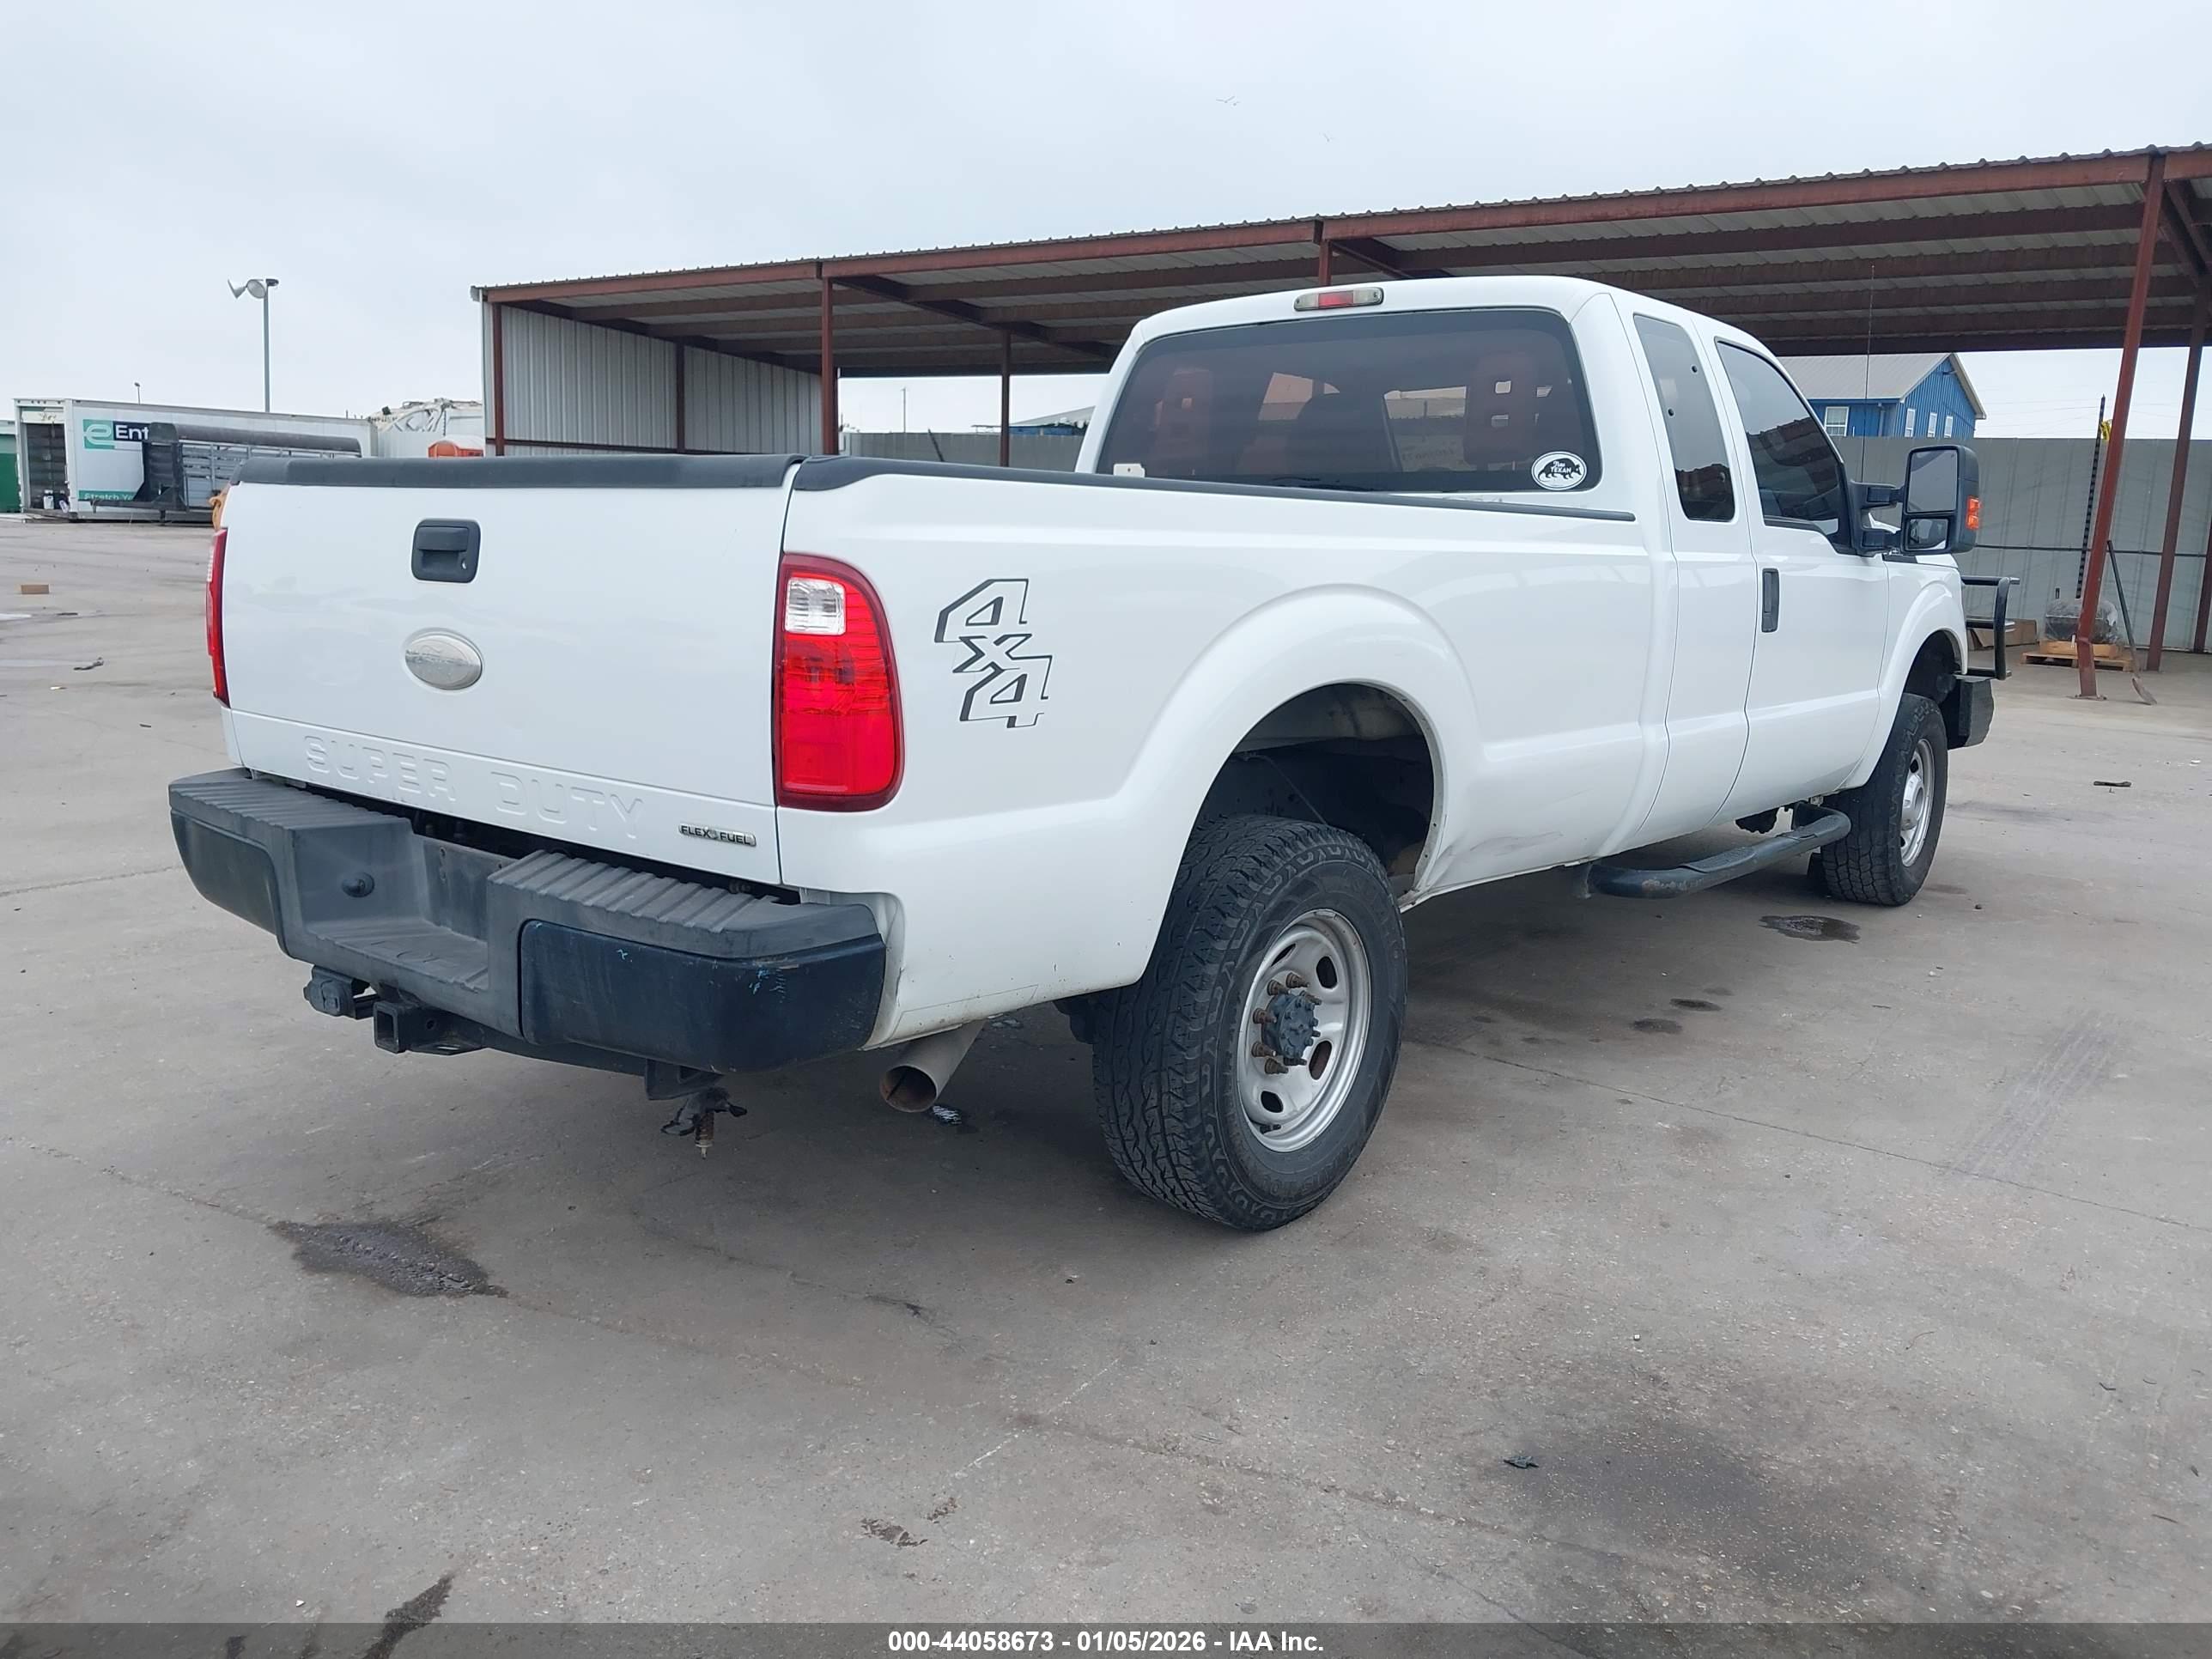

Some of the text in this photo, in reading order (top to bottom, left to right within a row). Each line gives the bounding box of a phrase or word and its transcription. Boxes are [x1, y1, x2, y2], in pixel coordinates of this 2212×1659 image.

[303, 734, 644, 840] SUPER DUTY
[680, 824, 751, 846] FLEX FUEL
